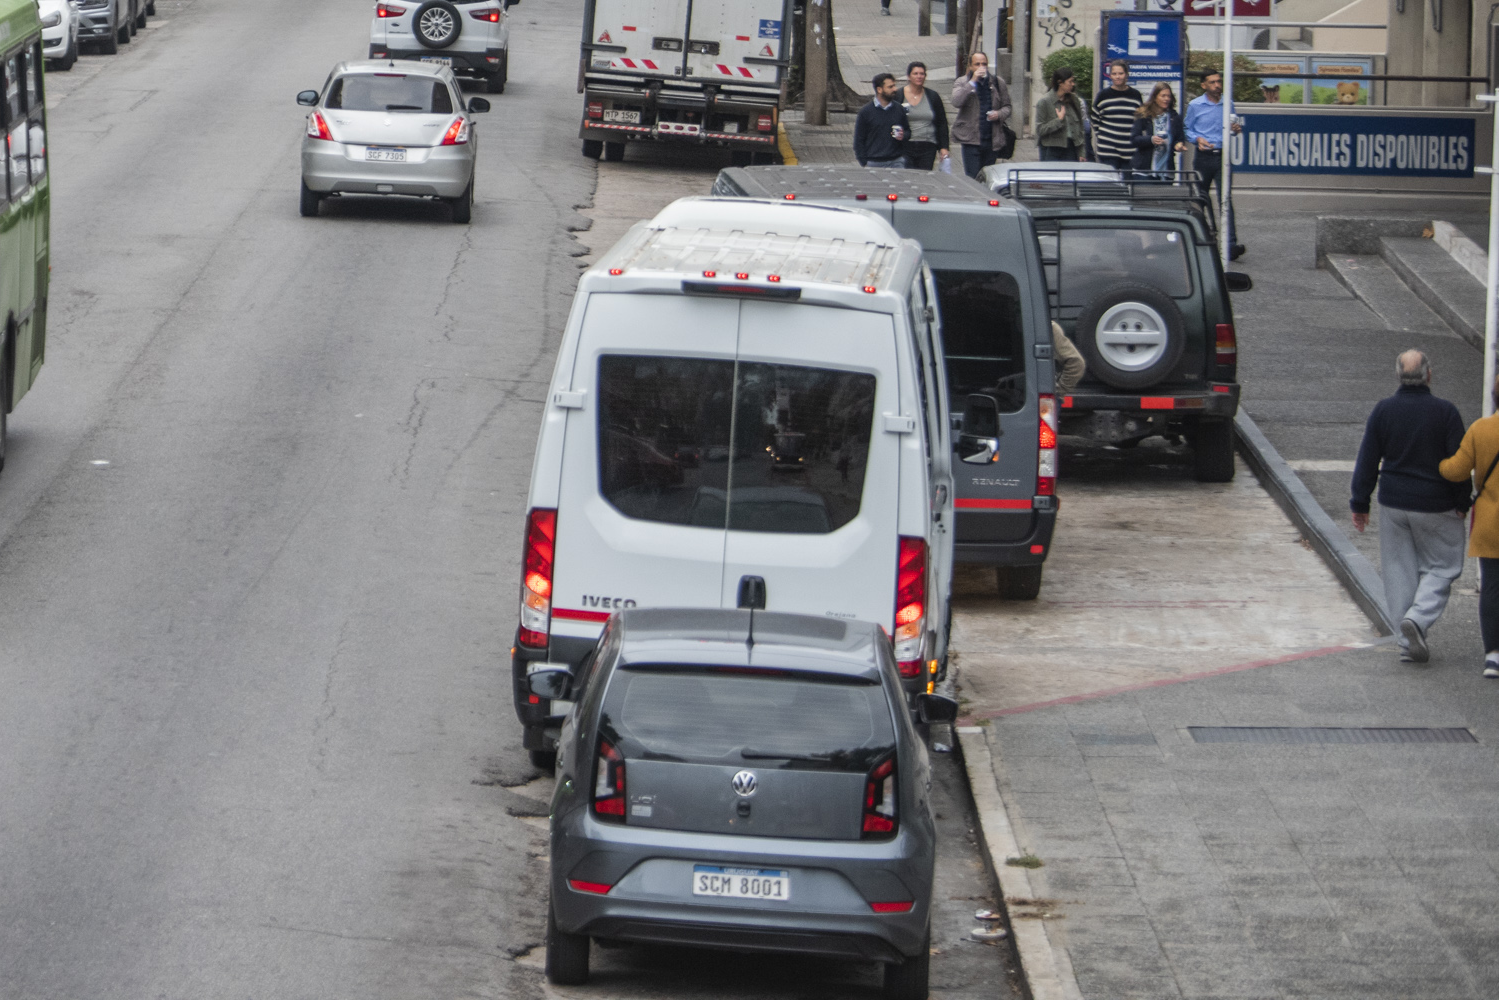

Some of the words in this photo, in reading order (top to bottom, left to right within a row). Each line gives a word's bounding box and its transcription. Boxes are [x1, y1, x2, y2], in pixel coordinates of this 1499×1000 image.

[1128, 21, 1158, 56] E
[605, 110, 619, 118] MTP
[621, 112, 639, 120] 1567
[368, 151, 382, 159] SCF
[385, 152, 405, 160] 7305
[1249, 131, 1351, 168] MENSUALES
[1356, 133, 1469, 170] DISPONIBLES
[972, 478, 1020, 486] RENAULT
[582, 594, 637, 608] IVECO
[724, 868, 759, 876] URUGUAY
[699, 875, 732, 894] SCM
[740, 879, 782, 897] 8001
